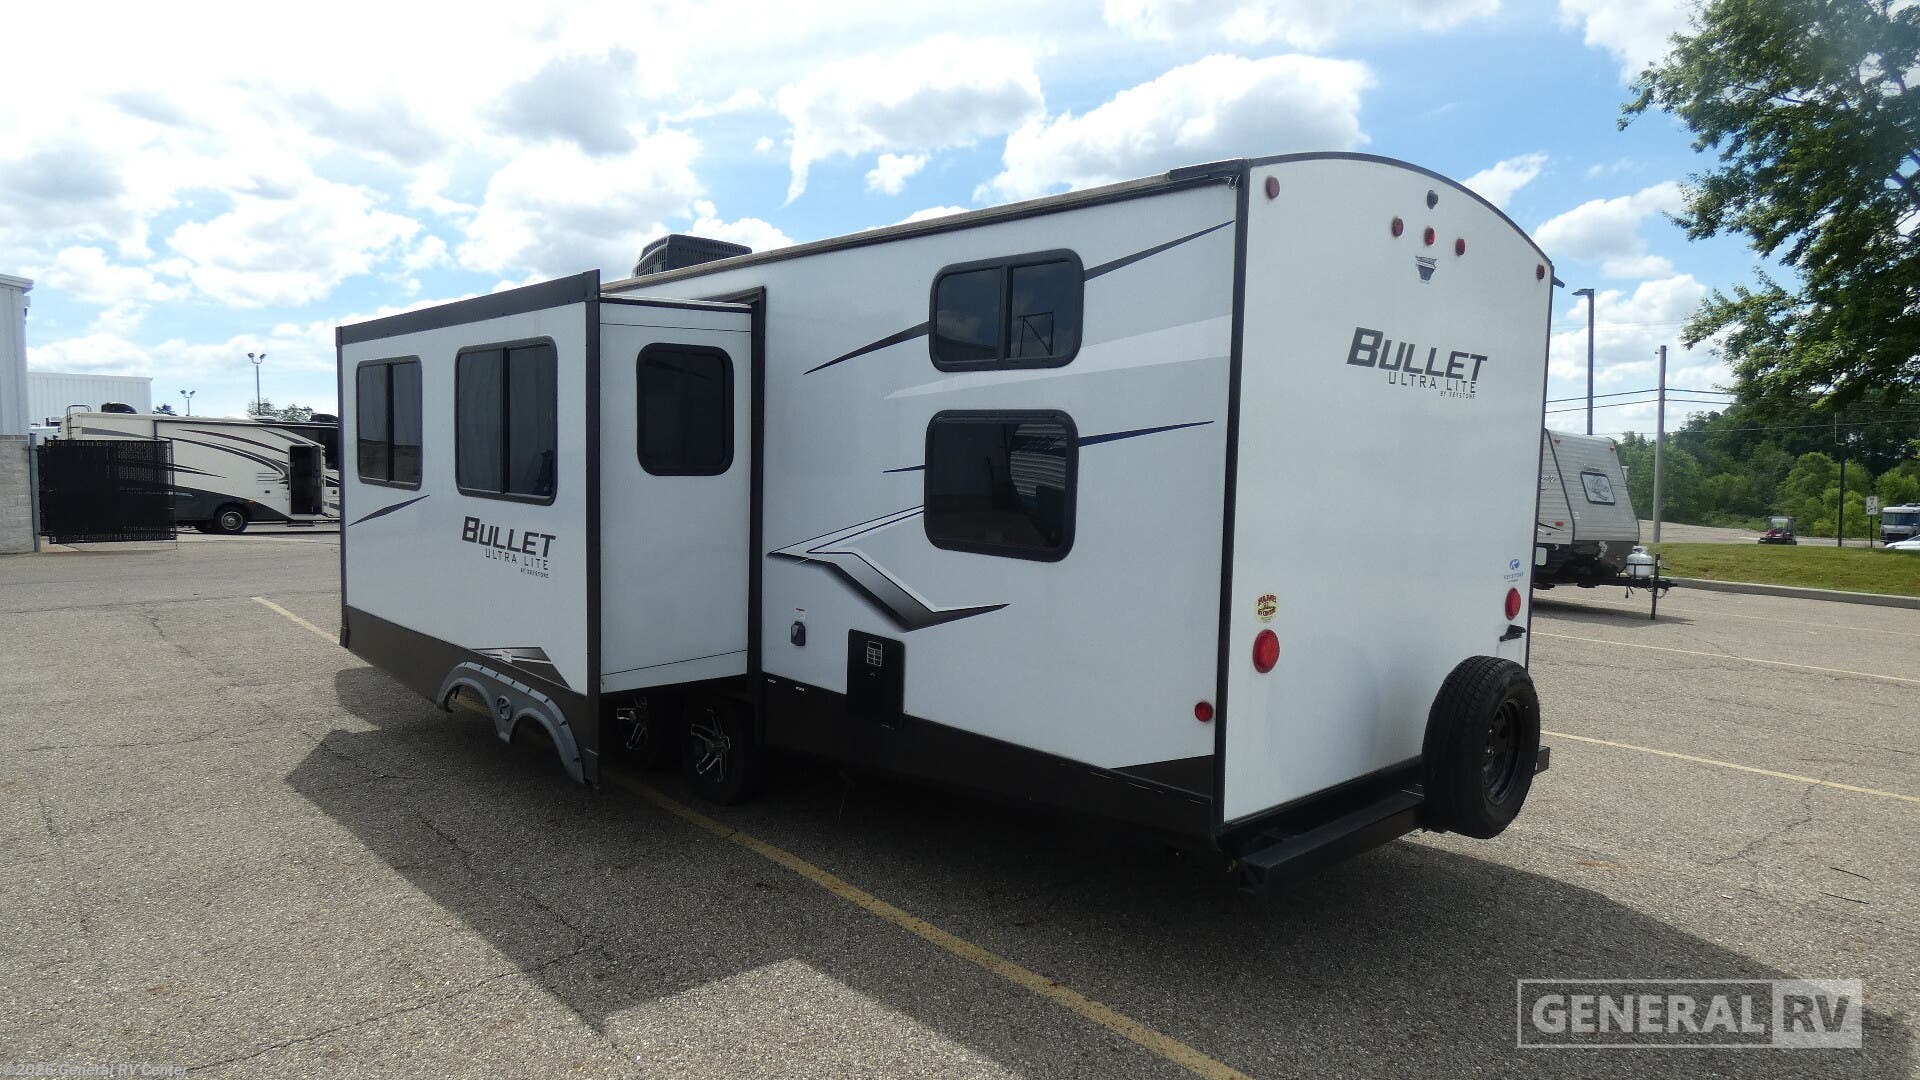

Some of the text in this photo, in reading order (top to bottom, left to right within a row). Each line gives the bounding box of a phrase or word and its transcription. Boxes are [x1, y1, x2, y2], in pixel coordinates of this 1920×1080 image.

[1346, 327, 1488, 380] BULLET
[1388, 371, 1476, 393] ULTRA LITE
[462, 516, 556, 557] BULLET
[485, 547, 549, 570] ULTRA LITE
